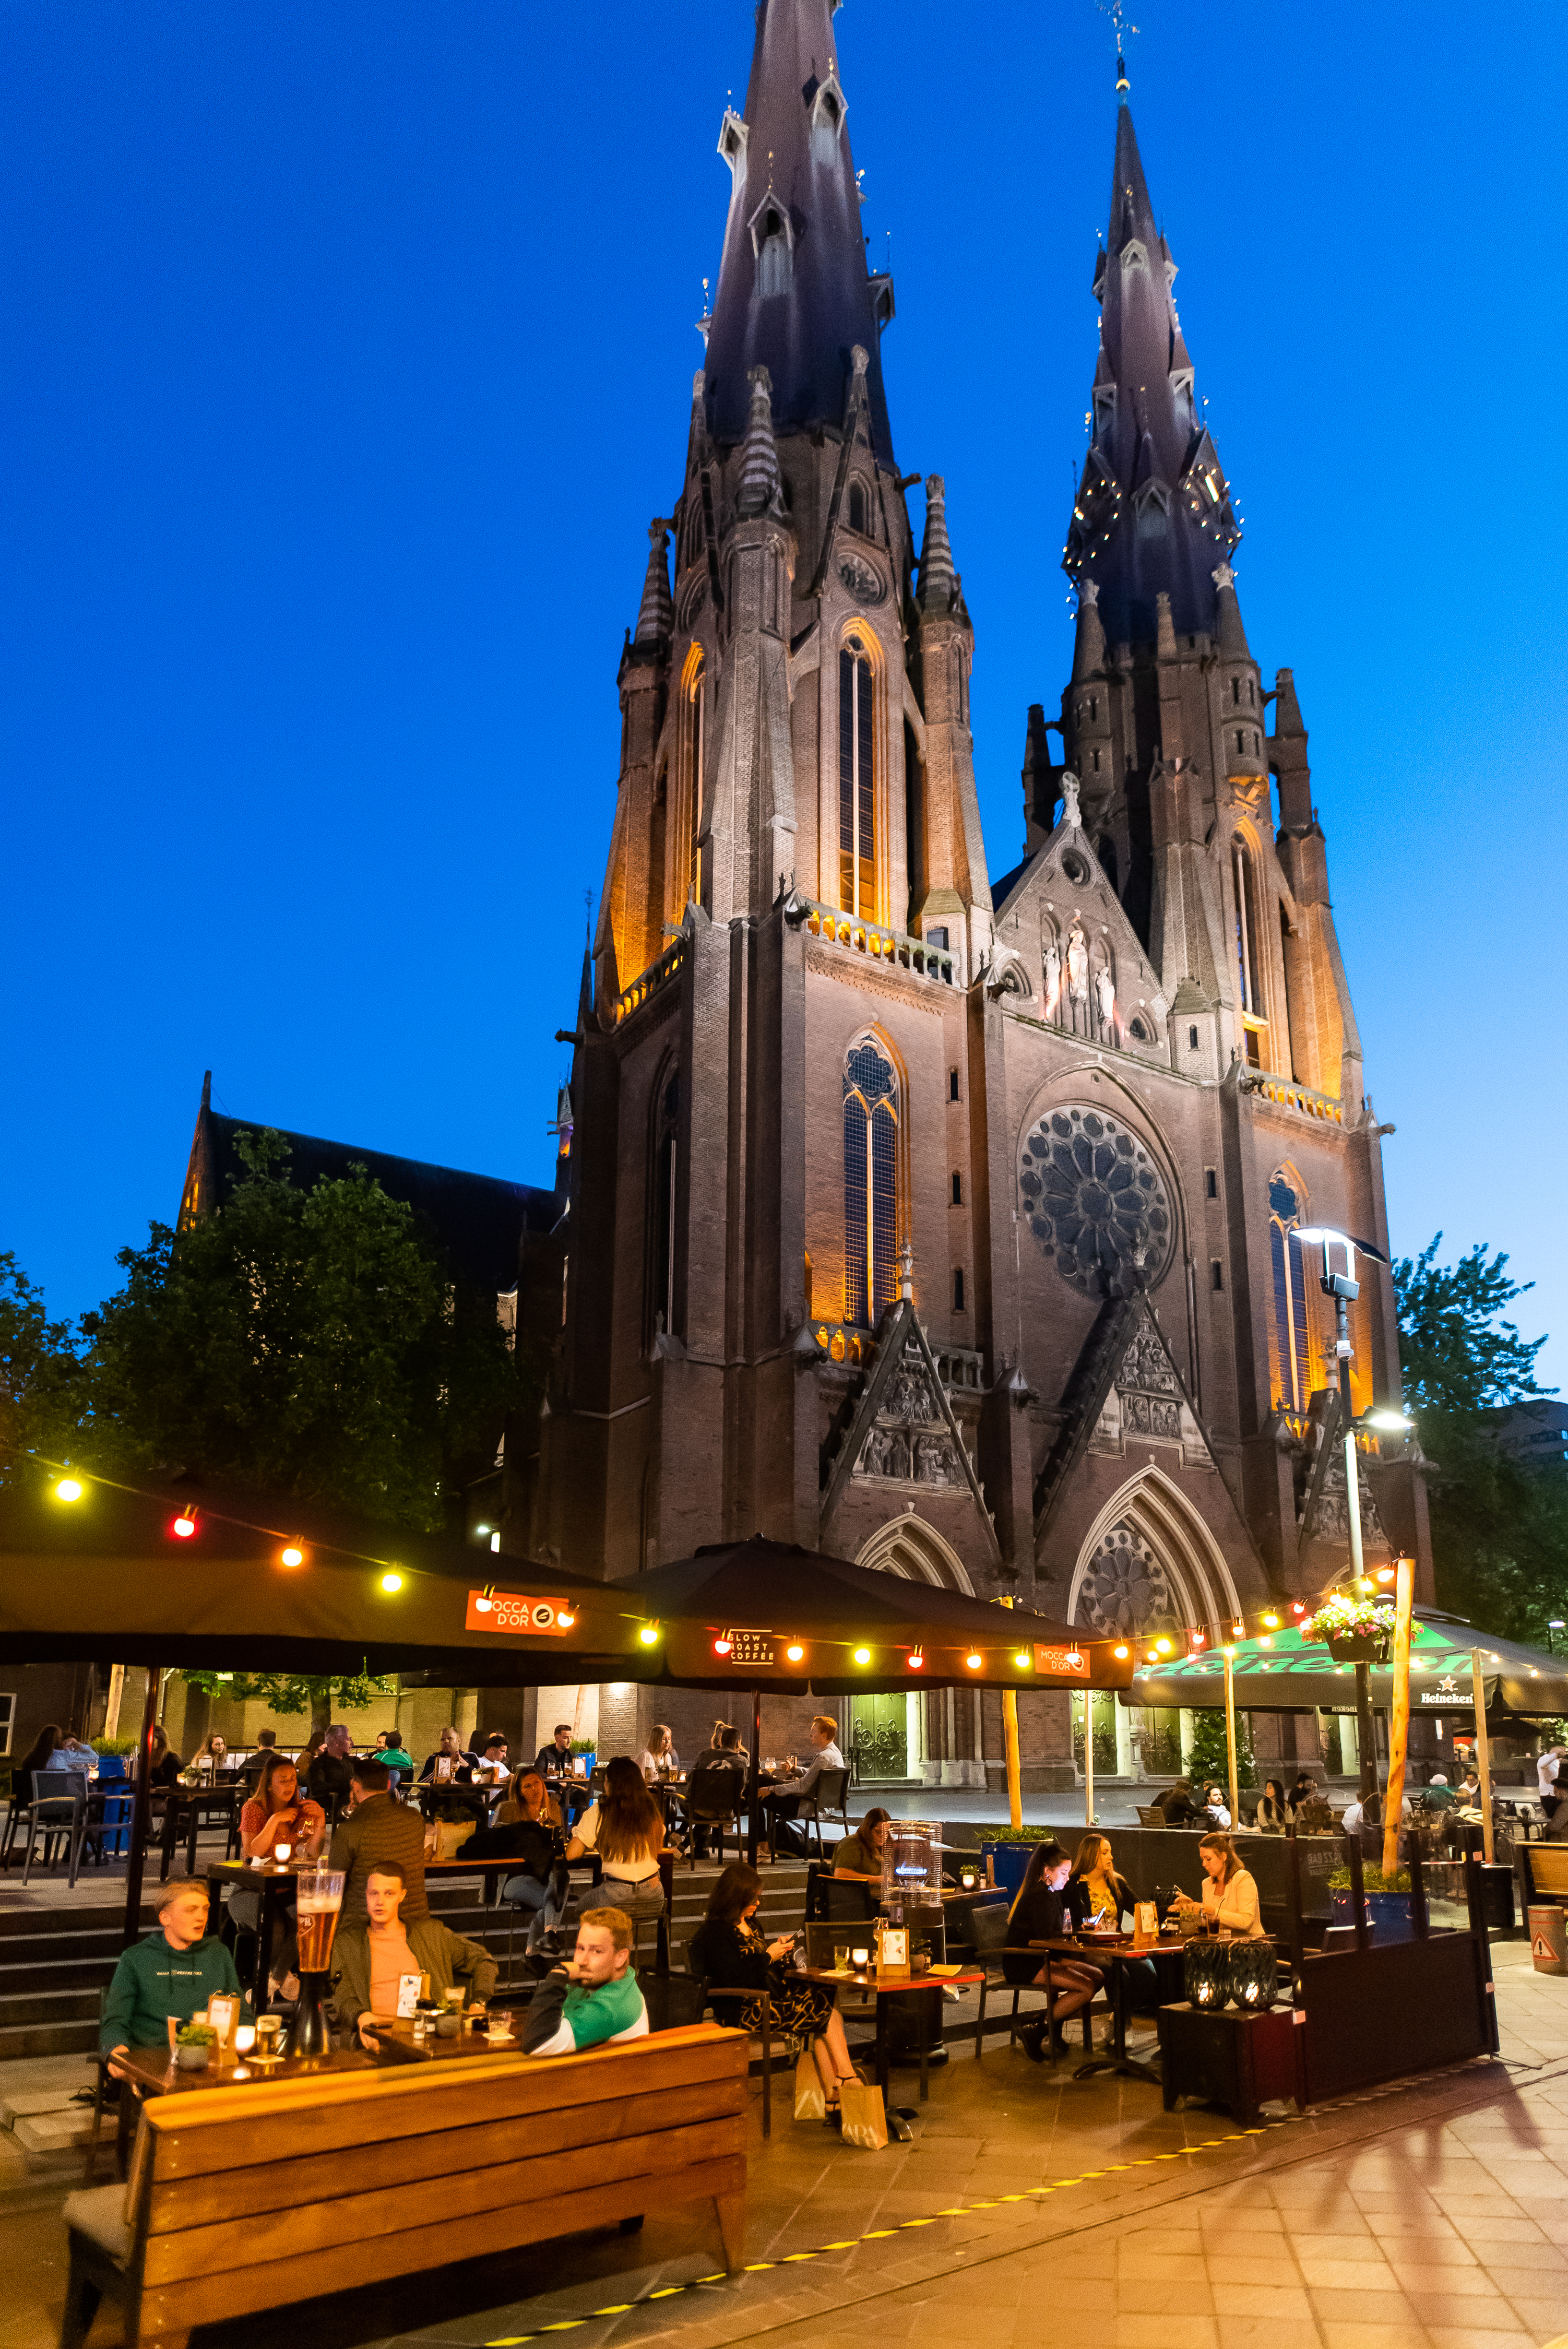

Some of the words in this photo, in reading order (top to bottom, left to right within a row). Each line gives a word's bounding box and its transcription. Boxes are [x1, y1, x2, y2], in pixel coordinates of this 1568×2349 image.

[492, 1600, 529, 1614] OCCA
[497, 1613, 529, 1627] D'OR
[1051, 1660, 1070, 1670] D'OR
[1421, 1693, 1474, 1704] Heineken
